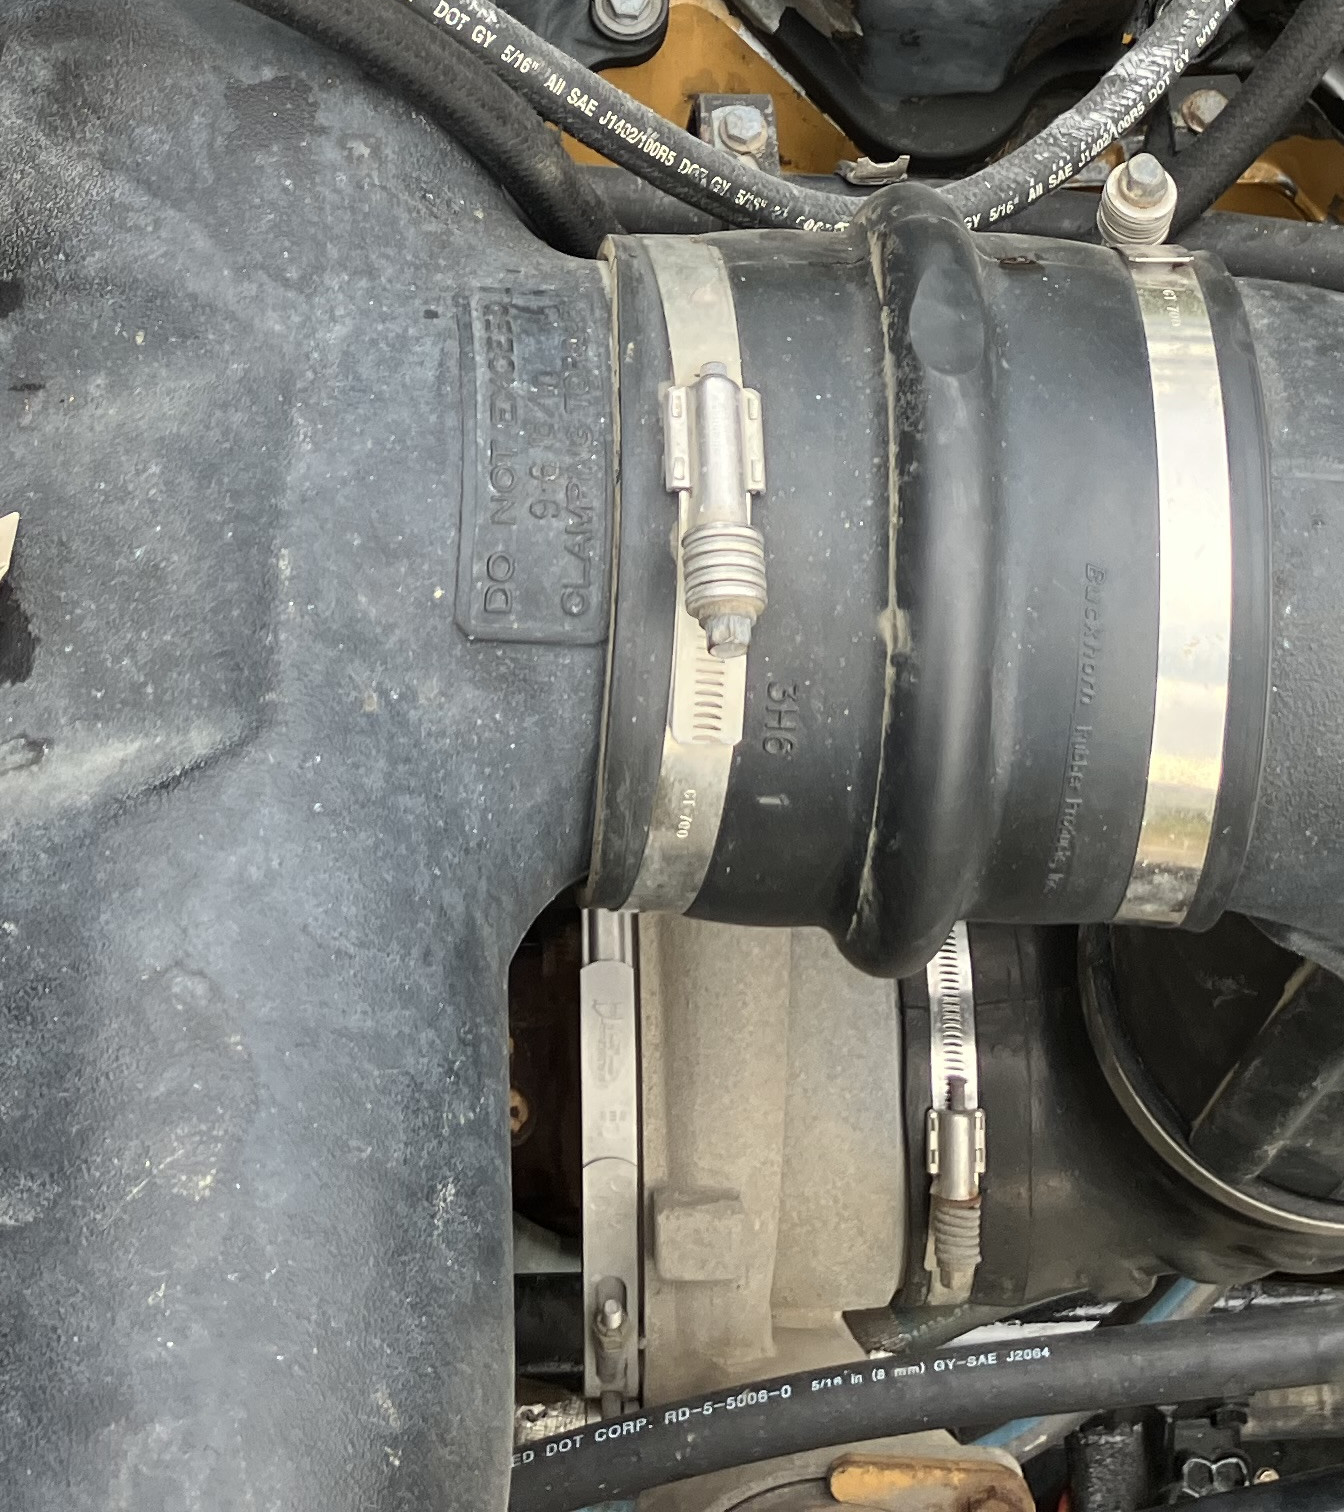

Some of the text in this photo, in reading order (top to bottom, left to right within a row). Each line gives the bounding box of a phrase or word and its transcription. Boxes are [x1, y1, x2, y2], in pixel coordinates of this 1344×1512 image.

[433, 0, 471, 31] DOT
[471, 25, 498, 49] GY
[501, 44, 540, 74] 5/16"
[566, 87, 599, 118] SAE
[989, 195, 1020, 223] 5/16"
[1048, 162, 1074, 189] SAE
[1147, 73, 1171, 104] DOT
[1174, 47, 1191, 75] GY
[481, 301, 518, 616] DO NOT EXCEED
[559, 420, 594, 618] CLAMPING
[1080, 561, 1106, 706] Buckhorn
[763, 680, 800, 756] 3H6
[675, 814, 693, 839] 700
[545, 1434, 585, 1458] DOT
[594, 1418, 654, 1443] CORP.
[664, 1384, 793, 1426] RD-5-5006-0
[894, 1362, 927, 1378] mm)
[933, 1352, 999, 1373] GY-SAE
[1006, 1346, 1052, 1364] J2064
